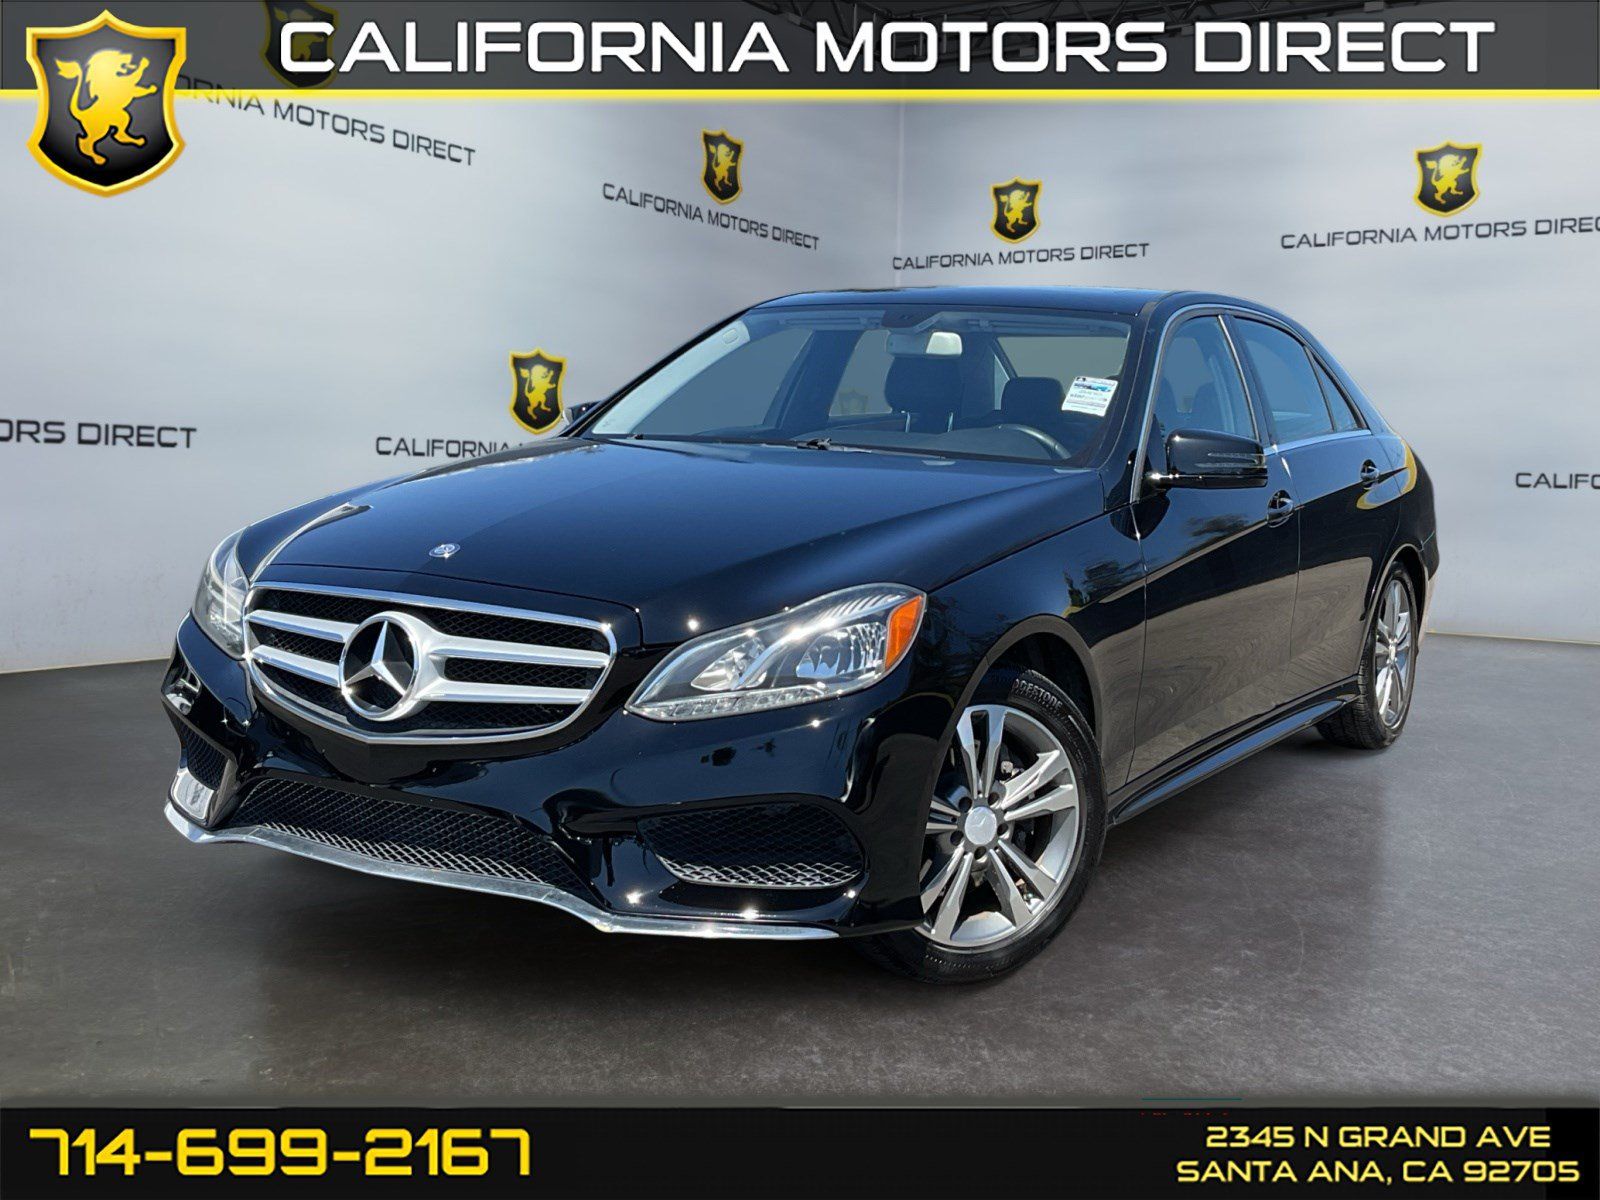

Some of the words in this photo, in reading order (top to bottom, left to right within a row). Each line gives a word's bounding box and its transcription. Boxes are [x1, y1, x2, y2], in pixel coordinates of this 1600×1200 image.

[273, 98, 386, 144] MOTORS
[392, 129, 476, 166] DIRECT
[602, 183, 704, 224] CALIFORNIA
[707, 209, 769, 239] MOTORS
[772, 225, 819, 250] DIRECT
[1280, 226, 1418, 249] CALIFORNIA
[1424, 220, 1527, 242] MOTORS
[892, 252, 994, 270] CALIFORNIA
[998, 247, 1075, 266] MOTORS
[1080, 243, 1150, 260] DIRECT
[77, 422, 197, 449] DIRECT
